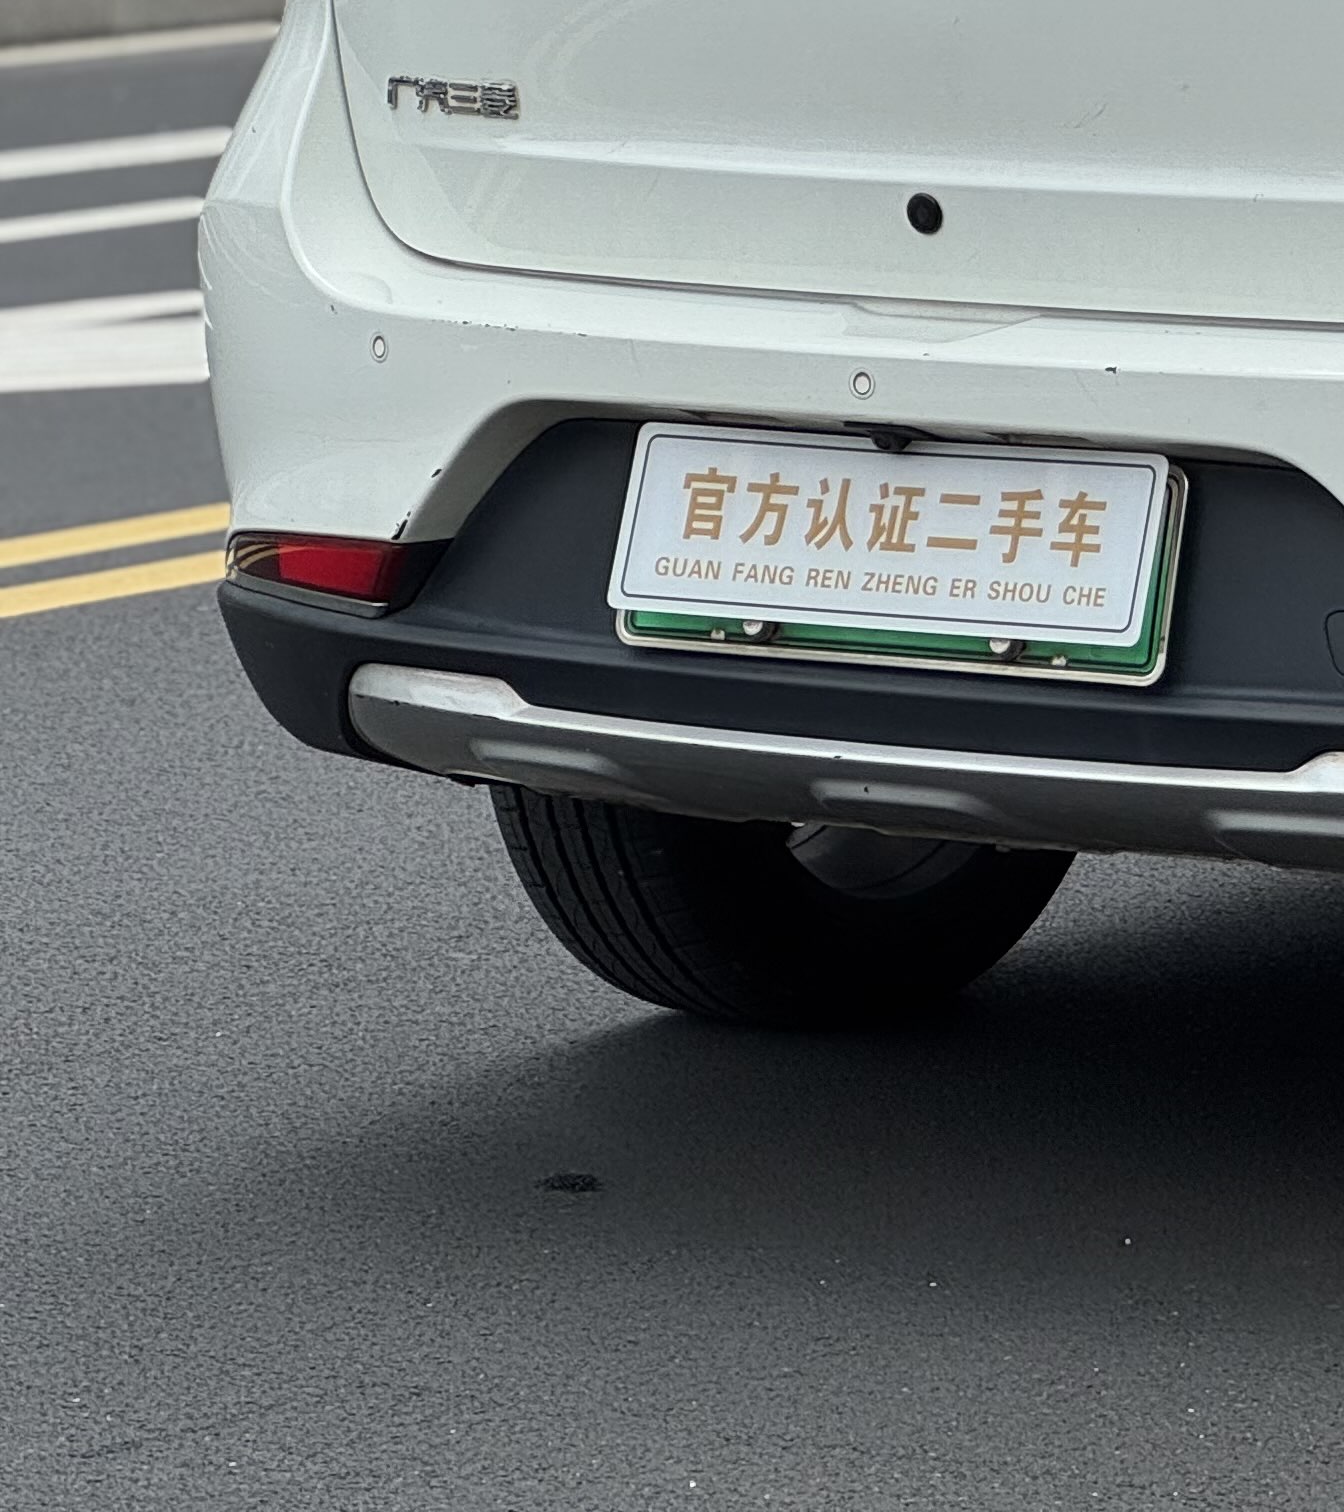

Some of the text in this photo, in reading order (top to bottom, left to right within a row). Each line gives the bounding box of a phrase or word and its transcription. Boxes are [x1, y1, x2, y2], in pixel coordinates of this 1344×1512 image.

[683, 467, 1107, 568] 官方认证二手车
[655, 556, 1107, 607] GUAN FANG REN ZHENG ER SHOU CHE
